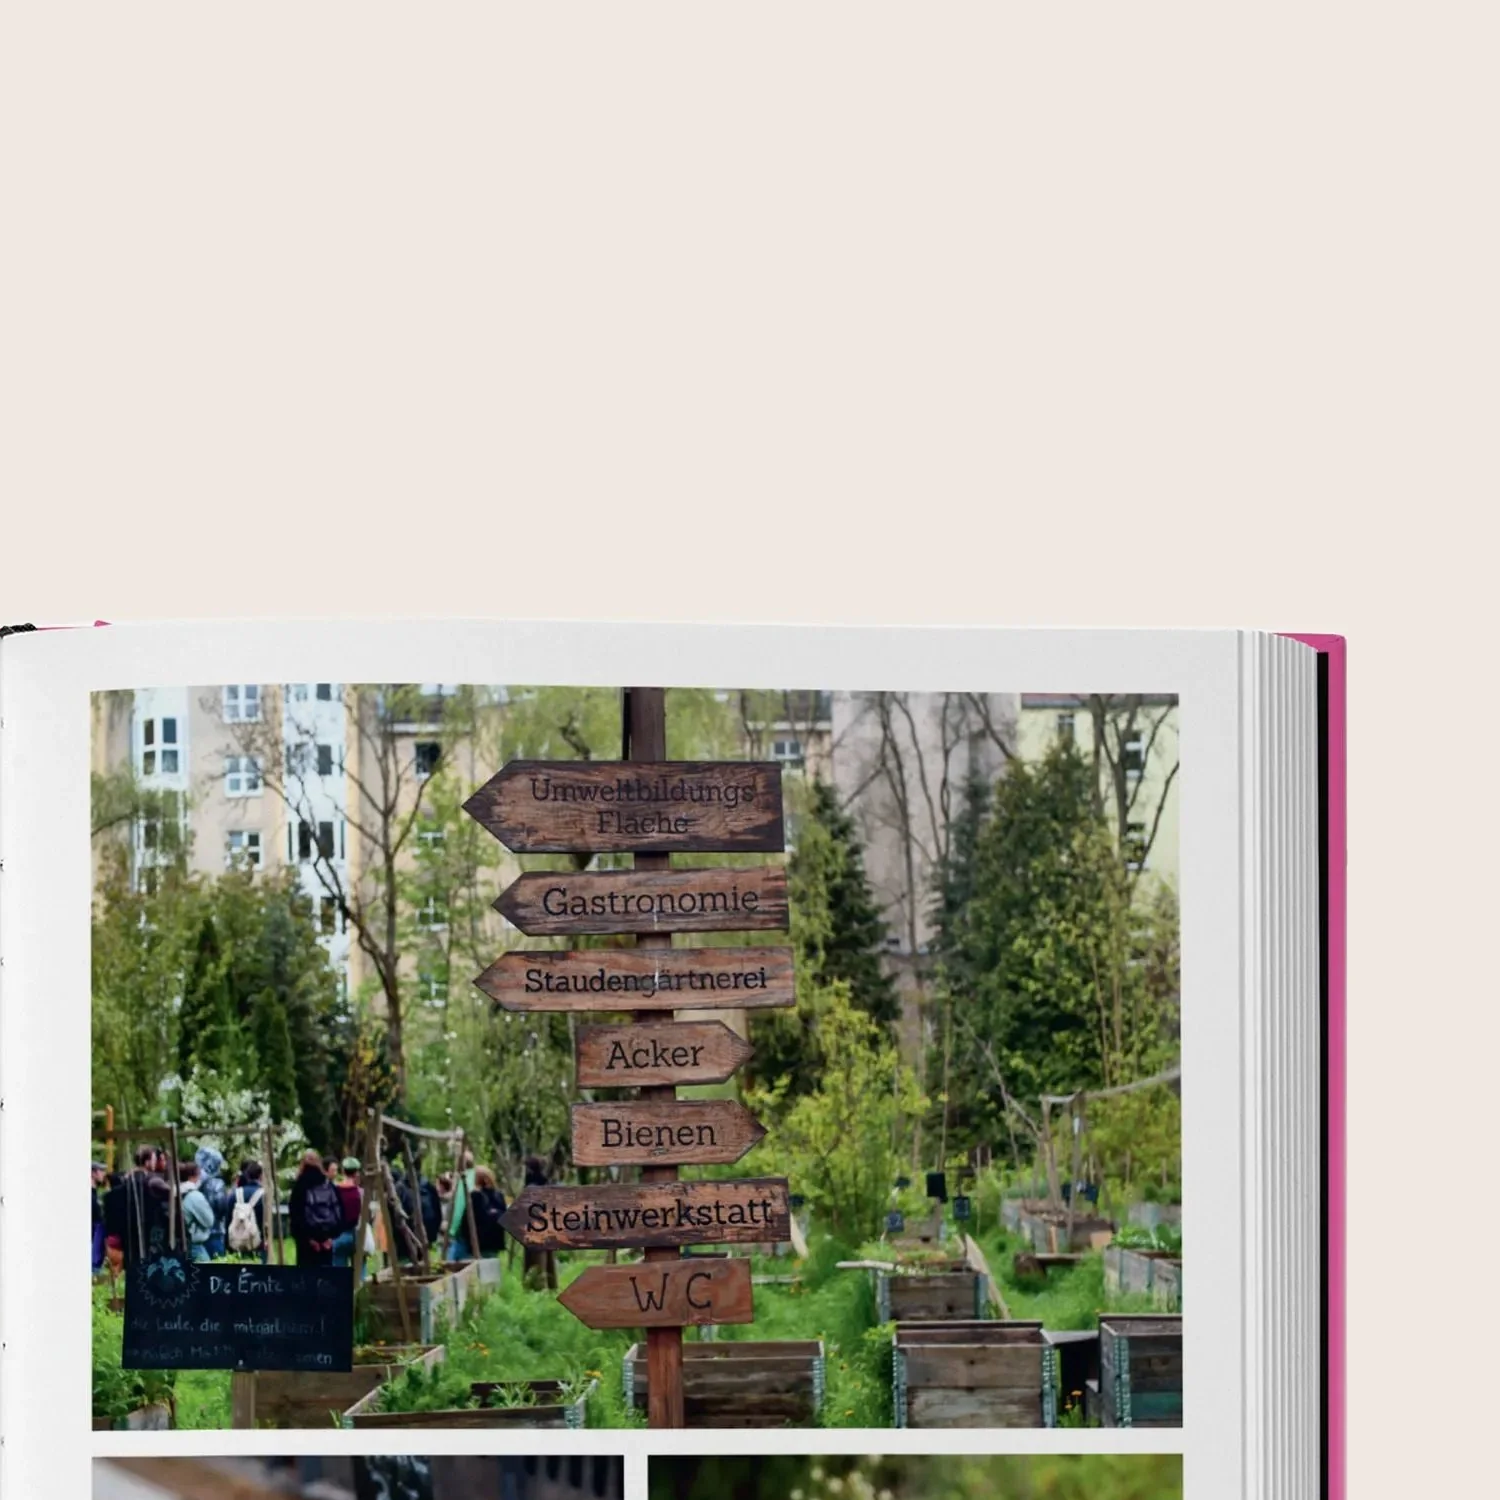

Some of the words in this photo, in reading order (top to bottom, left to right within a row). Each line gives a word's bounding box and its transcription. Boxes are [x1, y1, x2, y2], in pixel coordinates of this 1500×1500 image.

[531, 779, 755, 808] Umweltbildungs
[543, 886, 760, 916] Gastronomie
[525, 967, 767, 997] Staudengärtnerei
[605, 1040, 704, 1070] Acker
[601, 1118, 716, 1147] Bienen
[527, 1199, 774, 1233] Steinwerkstatt
[210, 1276, 231, 1294] Die
[200, 1318, 221, 1331] die
